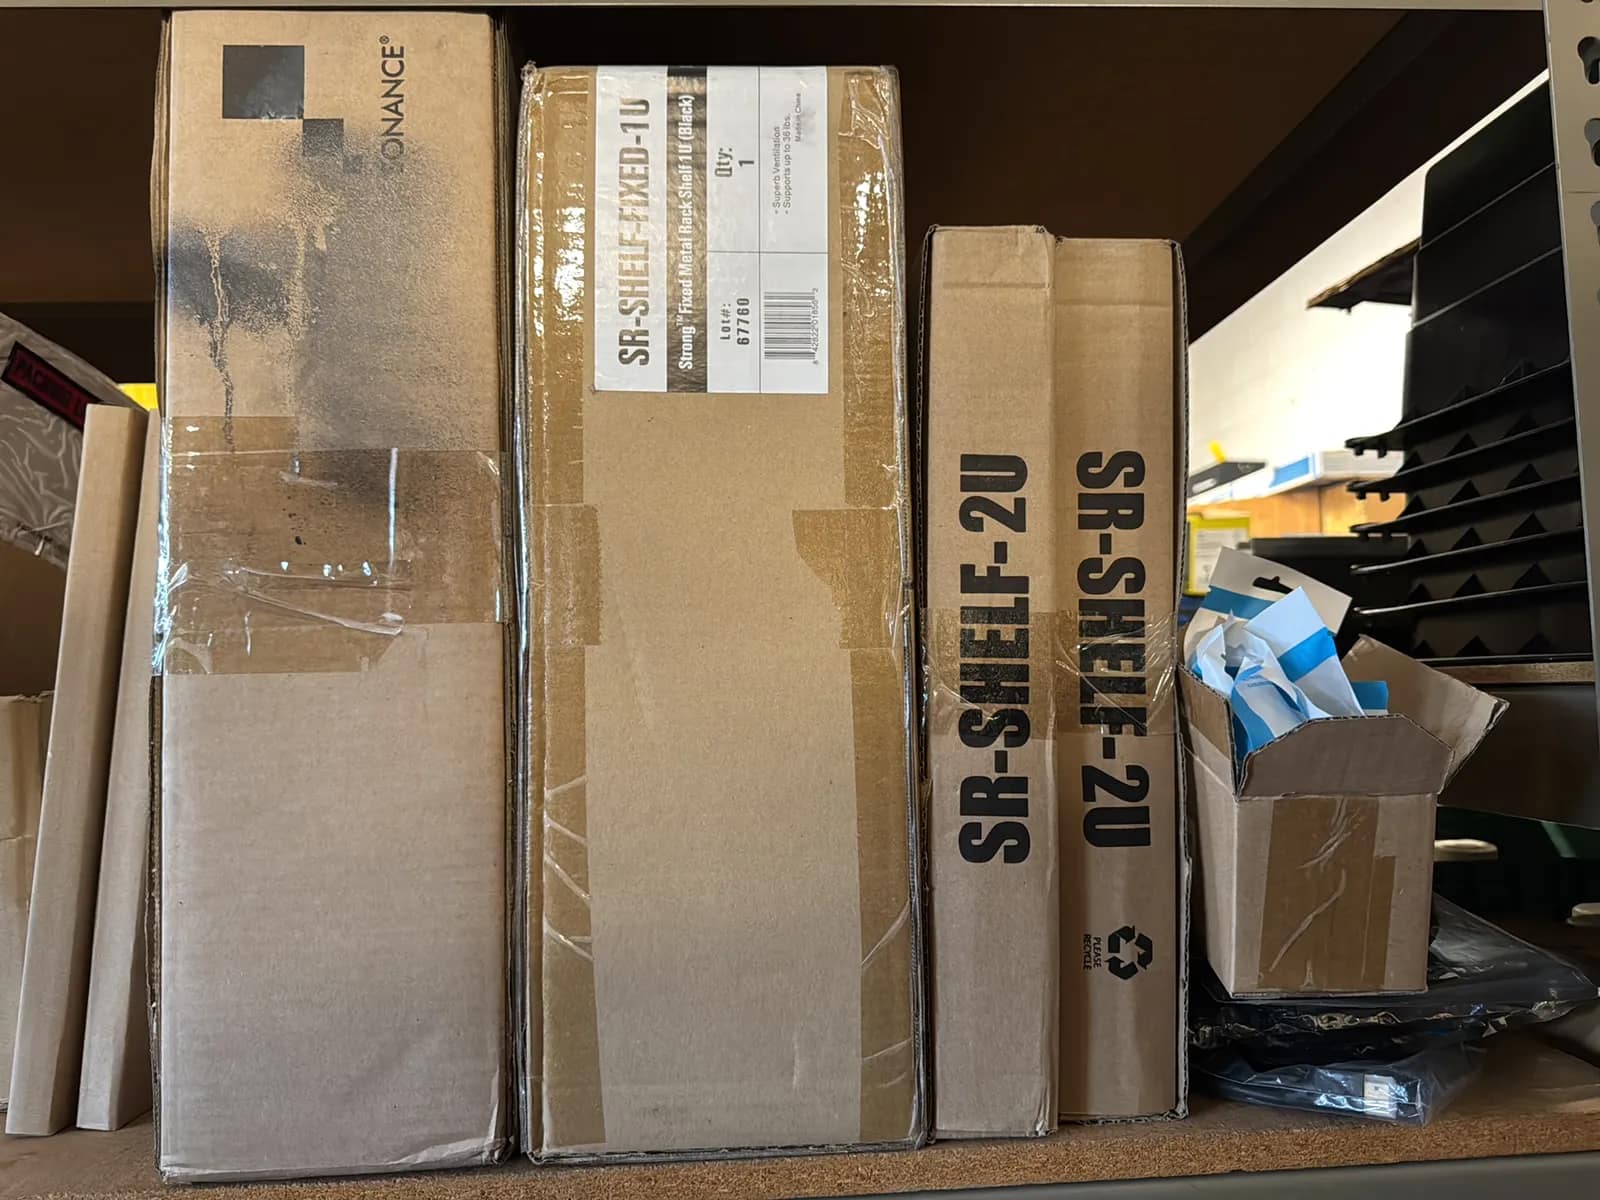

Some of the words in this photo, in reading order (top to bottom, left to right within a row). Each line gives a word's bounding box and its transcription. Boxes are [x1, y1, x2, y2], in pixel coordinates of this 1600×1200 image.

[677, 95, 695, 141] (Black)
[783, 113, 791, 130] lbs.
[678, 143, 693, 162] 1U
[772, 126, 781, 173] Ventilation
[783, 131, 791, 142] 36
[783, 144, 791, 152] to
[715, 147, 734, 178] Qty:
[784, 154, 792, 166] up
[678, 164, 693, 198] Shelf
[772, 175, 781, 208] Superb
[783, 167, 792, 208] Supports
[618, 98, 650, 366] SR-SHELF-FIXED-1U
[678, 201, 693, 234] Rack
[677, 238, 693, 276] Metal
[678, 280, 693, 314] Fixed
[719, 303, 732, 340] Lot#:
[736, 297, 750, 346] 67760
[959, 453, 1031, 864] SR-SHELF-2U
[1076, 450, 1152, 848] SR-SHELF-2U
[1082, 934, 1092, 970] RECYCLE
[1093, 937, 1102, 968] PLEASE
